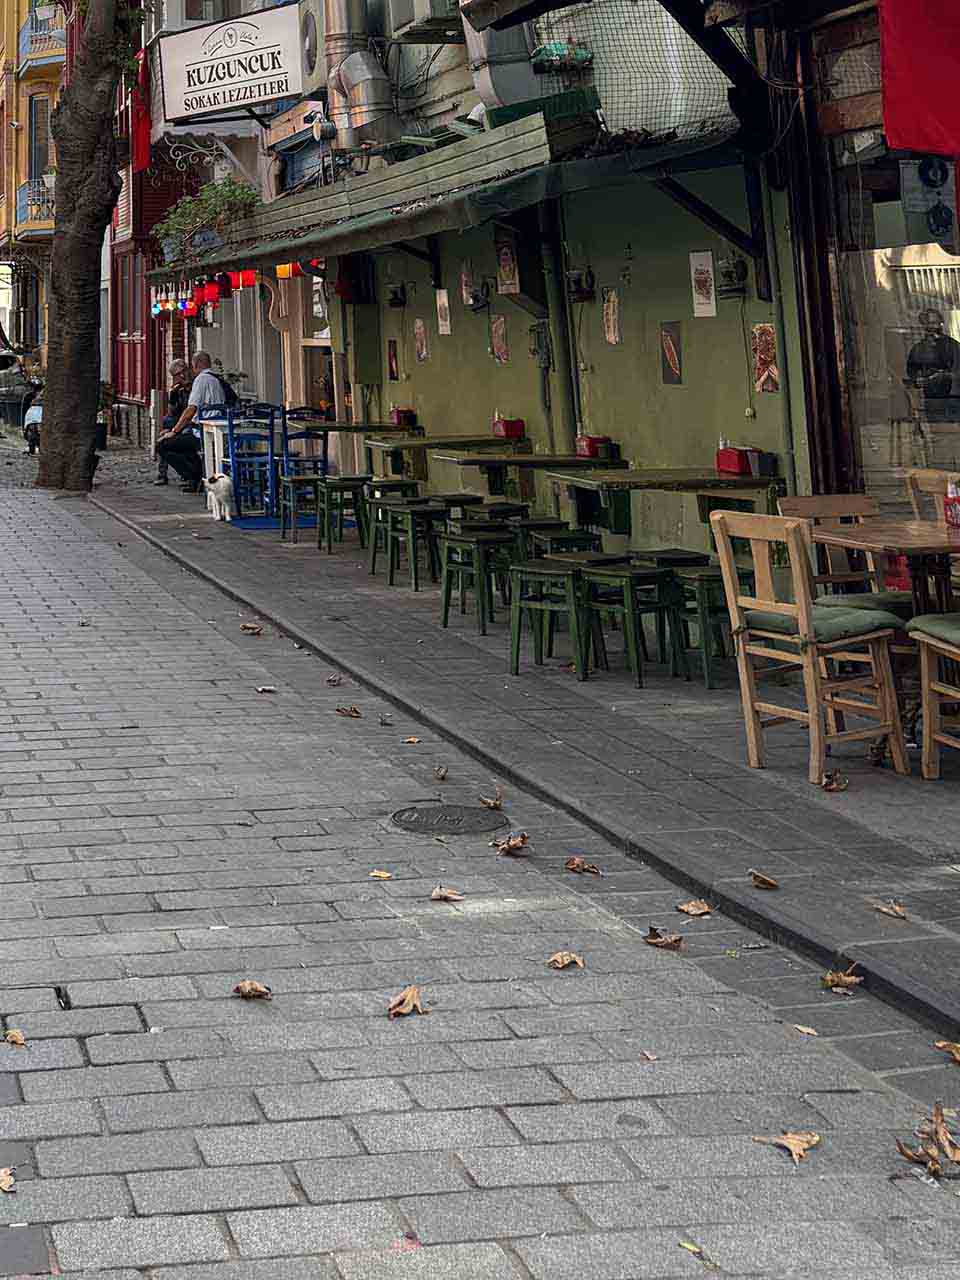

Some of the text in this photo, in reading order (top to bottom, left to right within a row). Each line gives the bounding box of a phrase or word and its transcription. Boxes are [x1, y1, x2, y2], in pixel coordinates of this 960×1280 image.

[186, 50, 282, 87] KUZGUNCUK
[184, 75, 289, 111] SOKAK LEZZETLERİ
